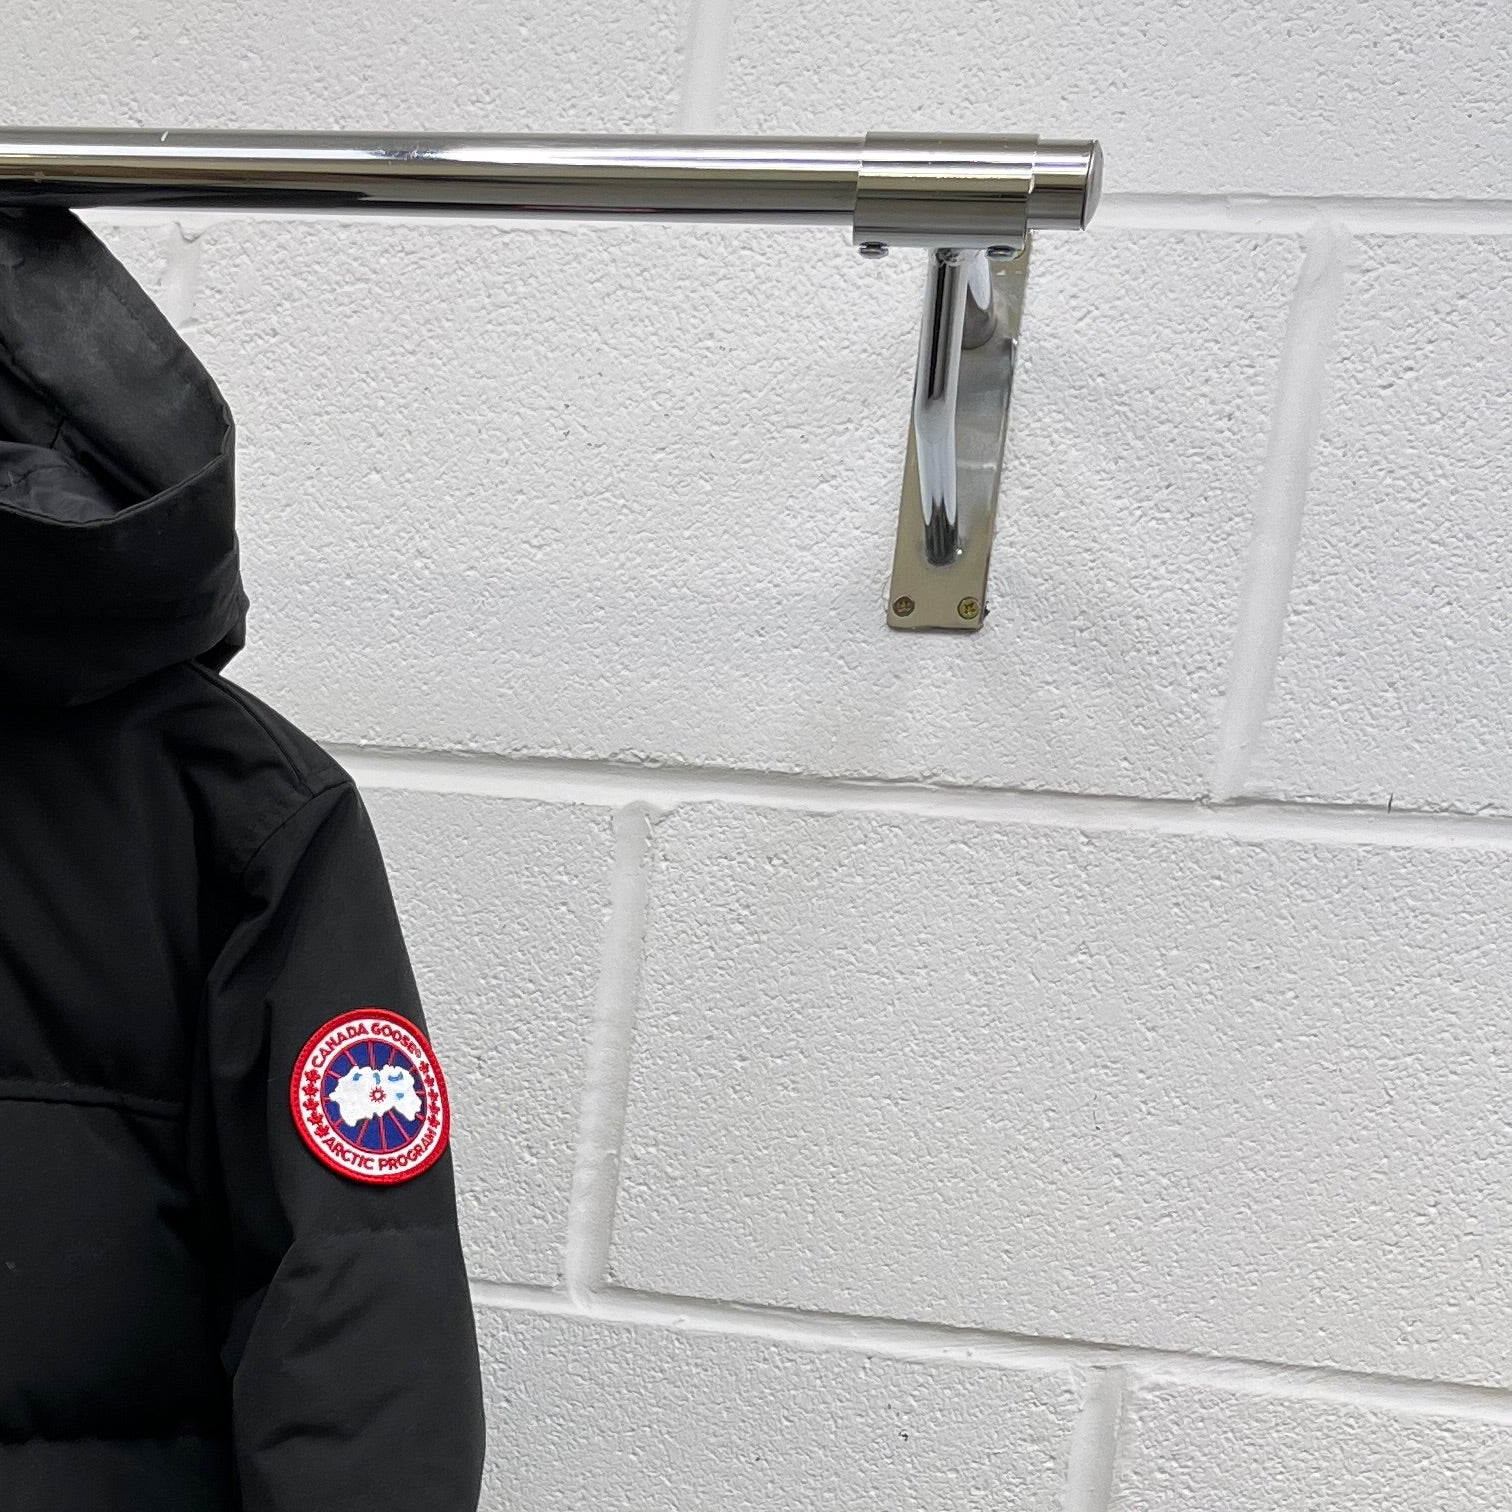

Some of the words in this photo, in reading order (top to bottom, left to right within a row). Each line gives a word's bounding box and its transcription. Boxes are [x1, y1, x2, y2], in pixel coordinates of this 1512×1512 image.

[311, 1023, 369, 1068] CANADA
[322, 1136, 374, 1170] ARCTIC
[378, 1128, 437, 1171] PROGRAM
